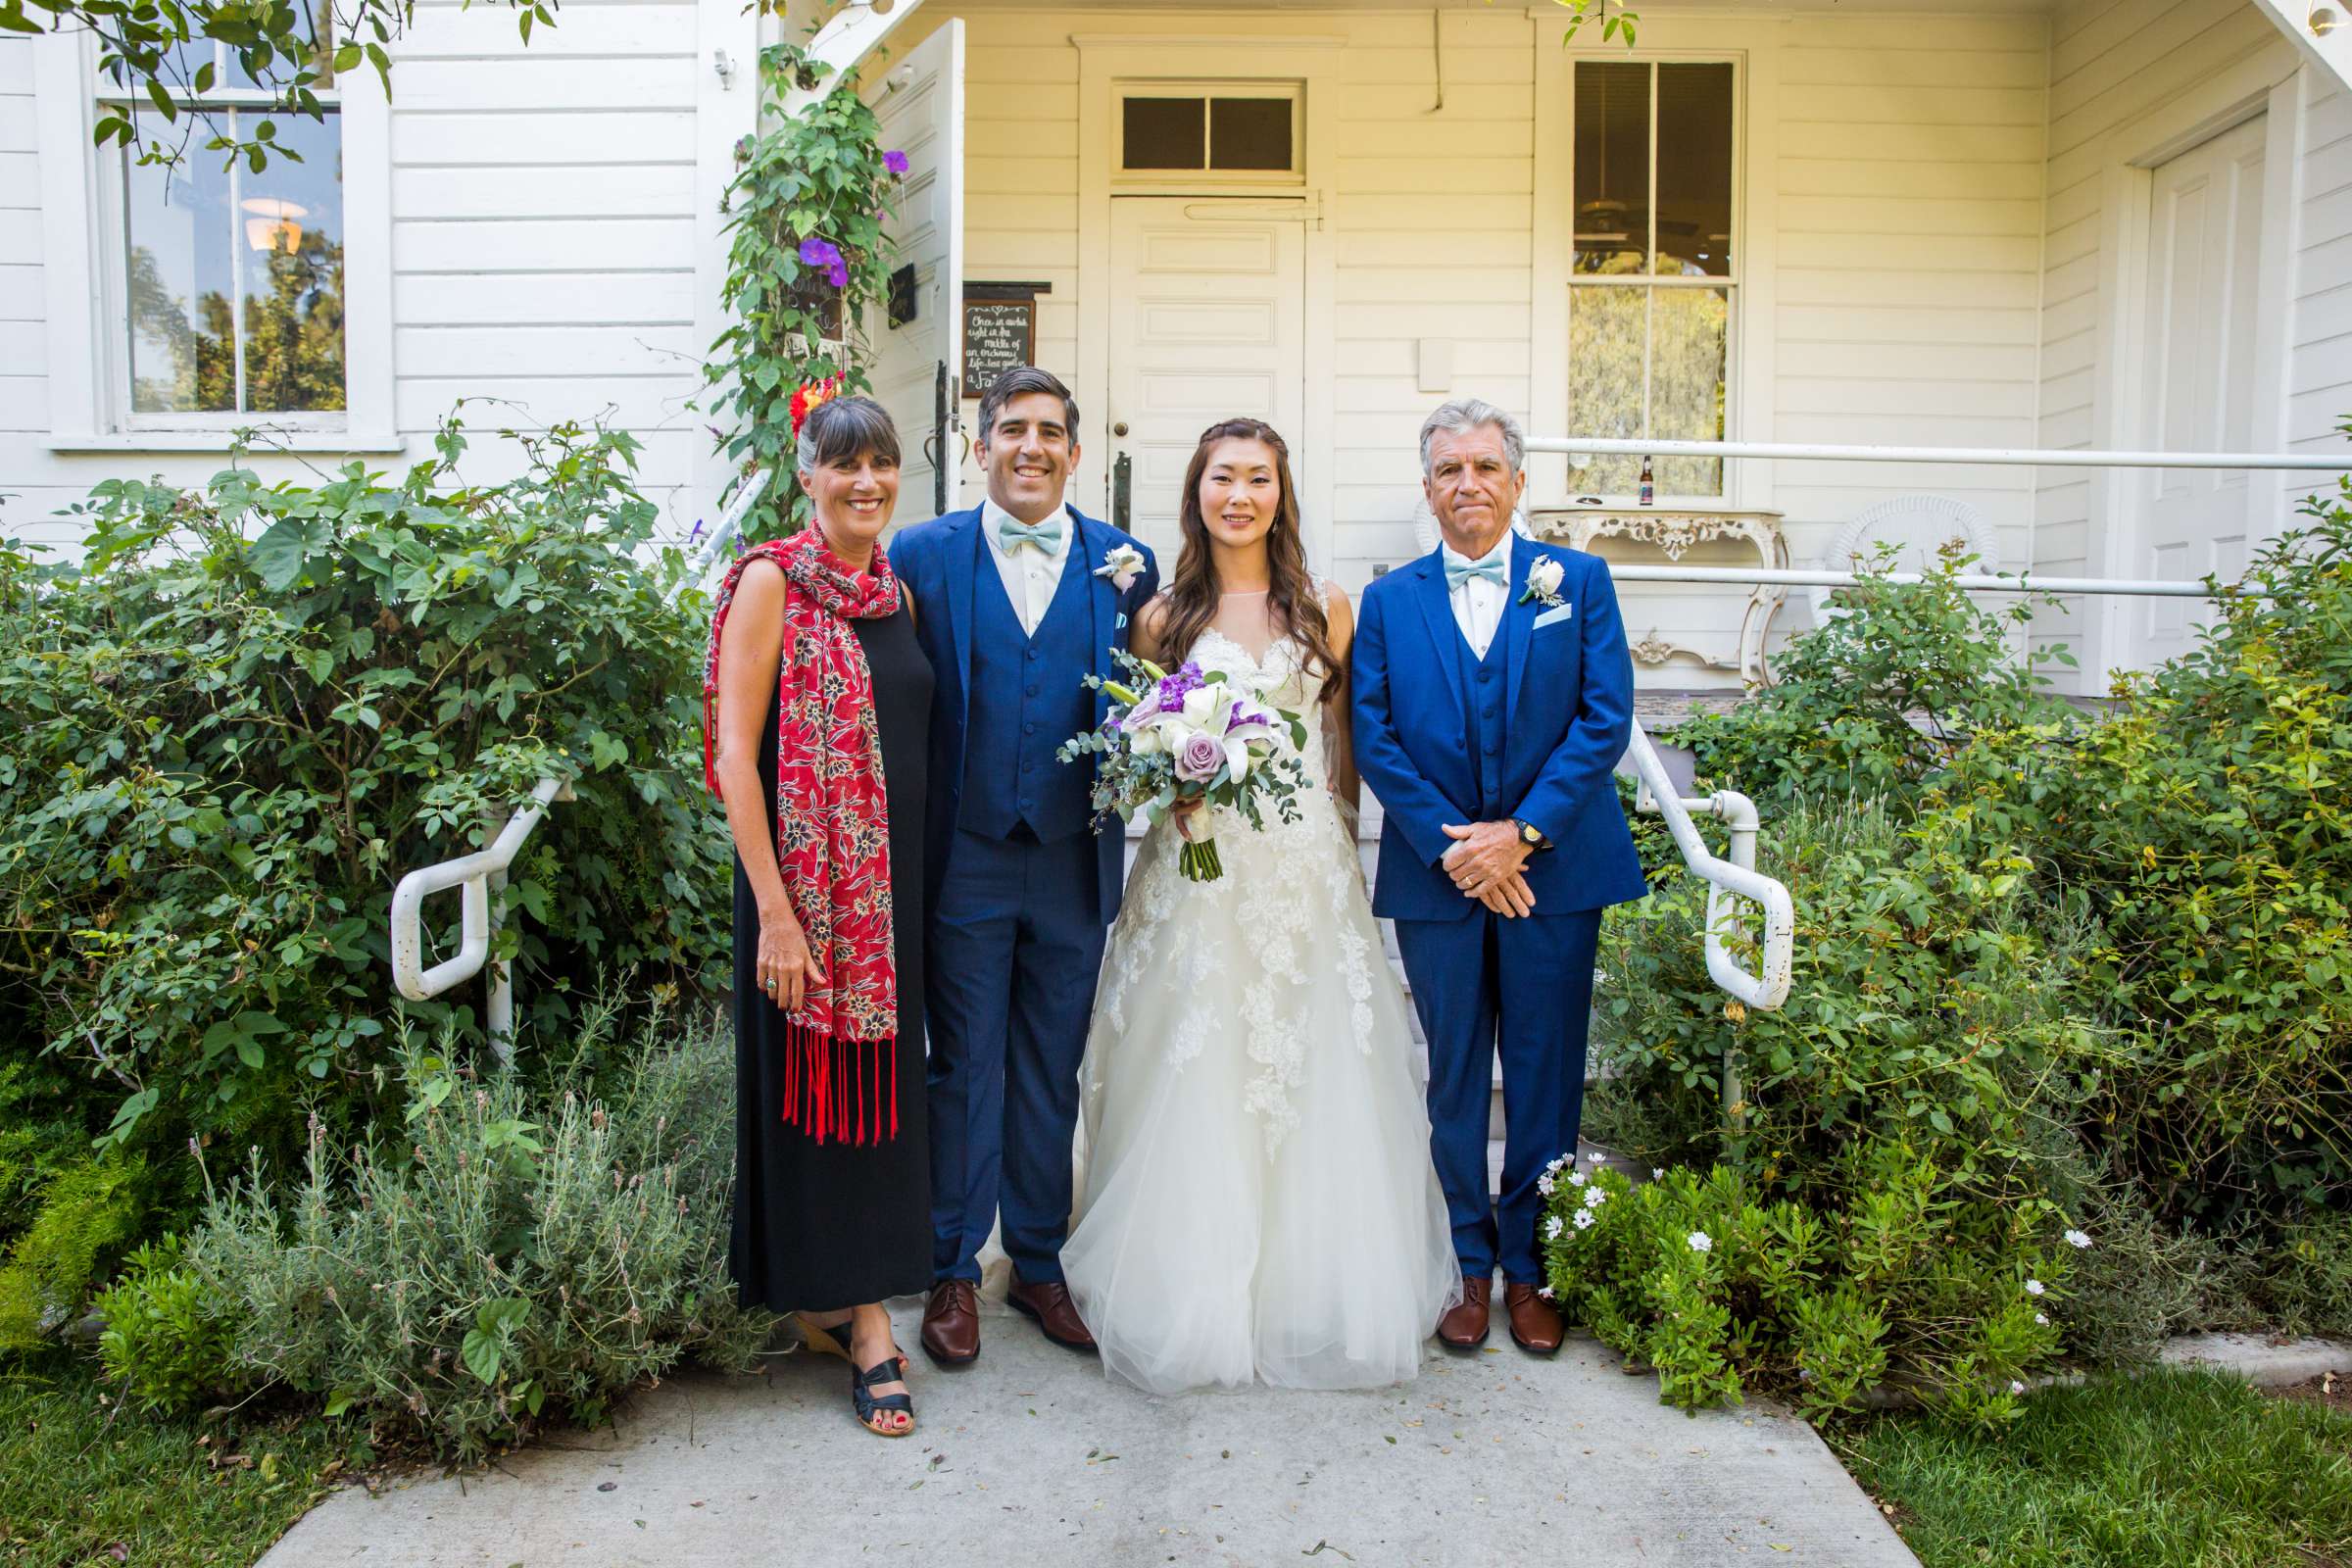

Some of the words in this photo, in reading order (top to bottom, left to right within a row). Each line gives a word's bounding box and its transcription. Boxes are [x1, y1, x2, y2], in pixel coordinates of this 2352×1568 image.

[972, 316, 994, 326] Once
[967, 326, 988, 341] right
[984, 338, 1010, 348] middle
[1011, 339, 1021, 351] of
[966, 374, 975, 383] a
